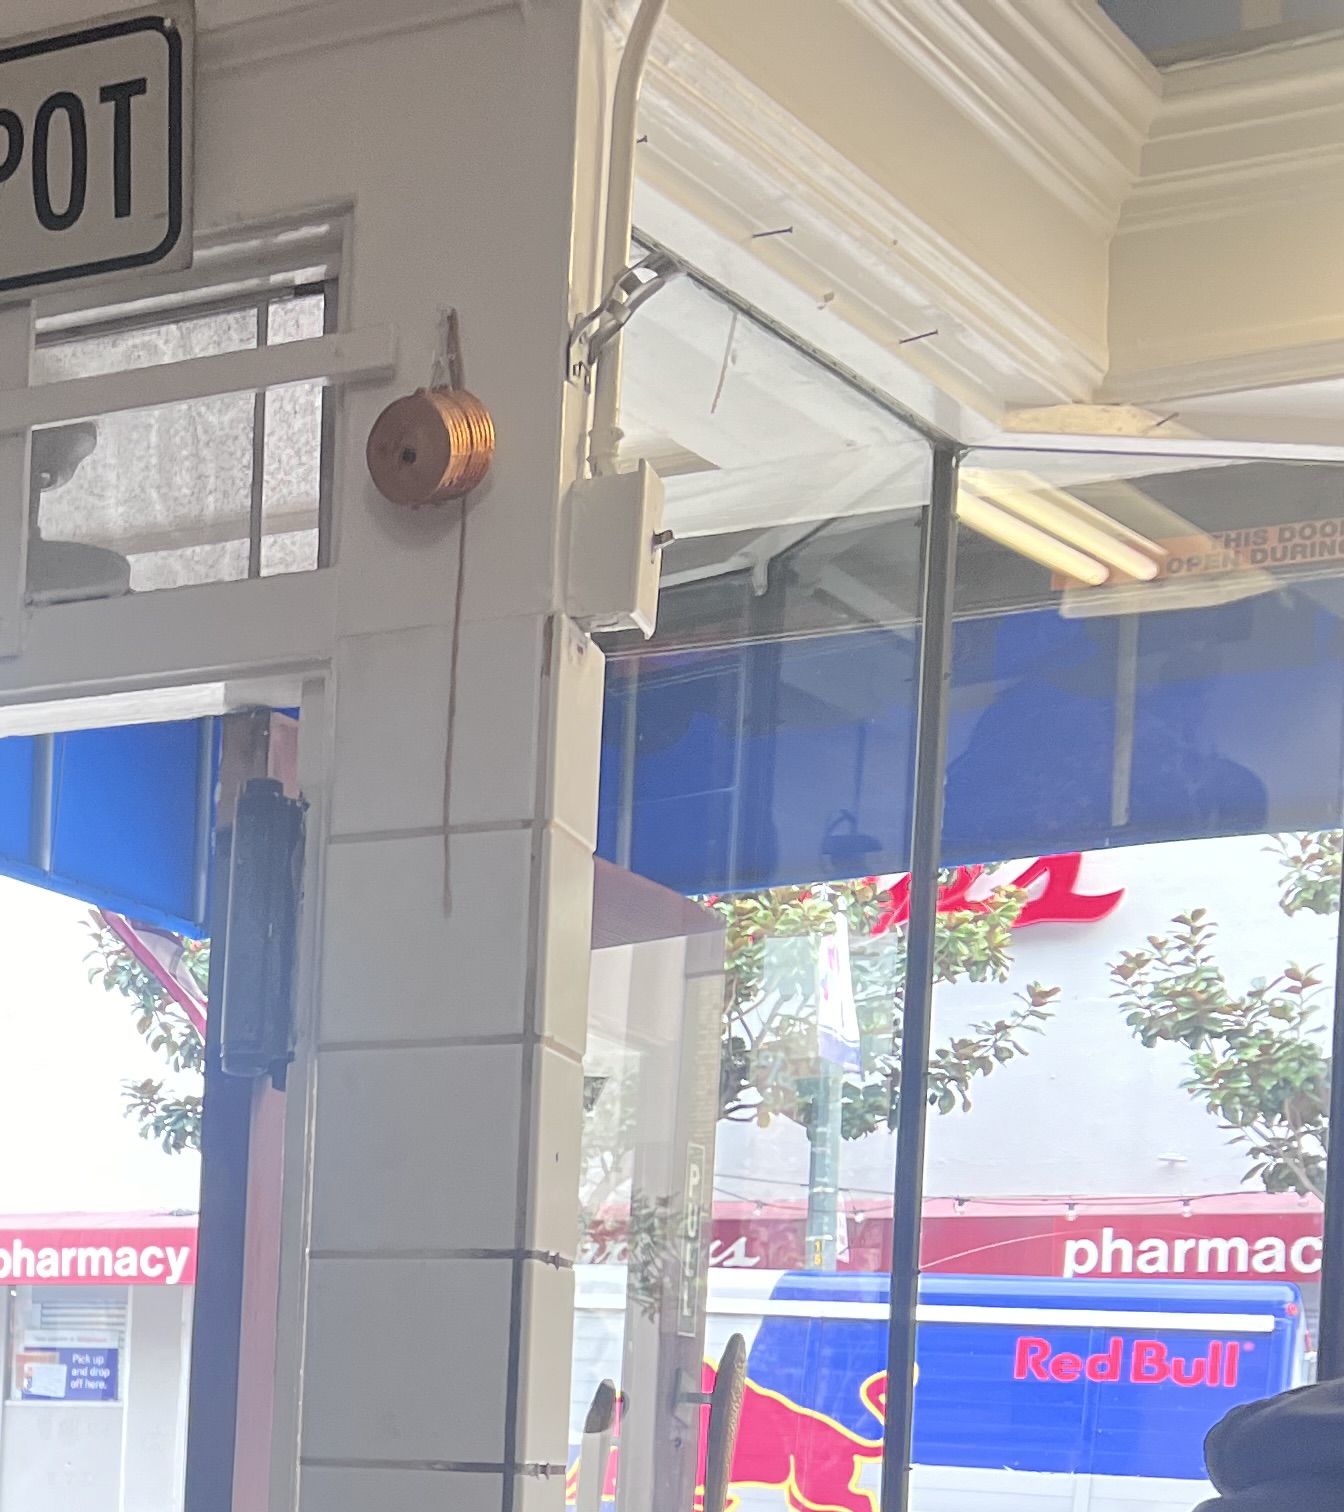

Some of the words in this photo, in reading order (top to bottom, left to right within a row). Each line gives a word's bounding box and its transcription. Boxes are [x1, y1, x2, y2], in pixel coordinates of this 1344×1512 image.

[1251, 541, 1344, 565] DURIN
[72, 1353, 90, 1365] Pick
[93, 1355, 104, 1366] up
[1014, 1336, 1122, 1381] Red
[1130, 1340, 1240, 1387] Bull
[72, 1367, 87, 1377] and
[90, 1367, 110, 1378] drop
[70, 1380, 83, 1389] off
